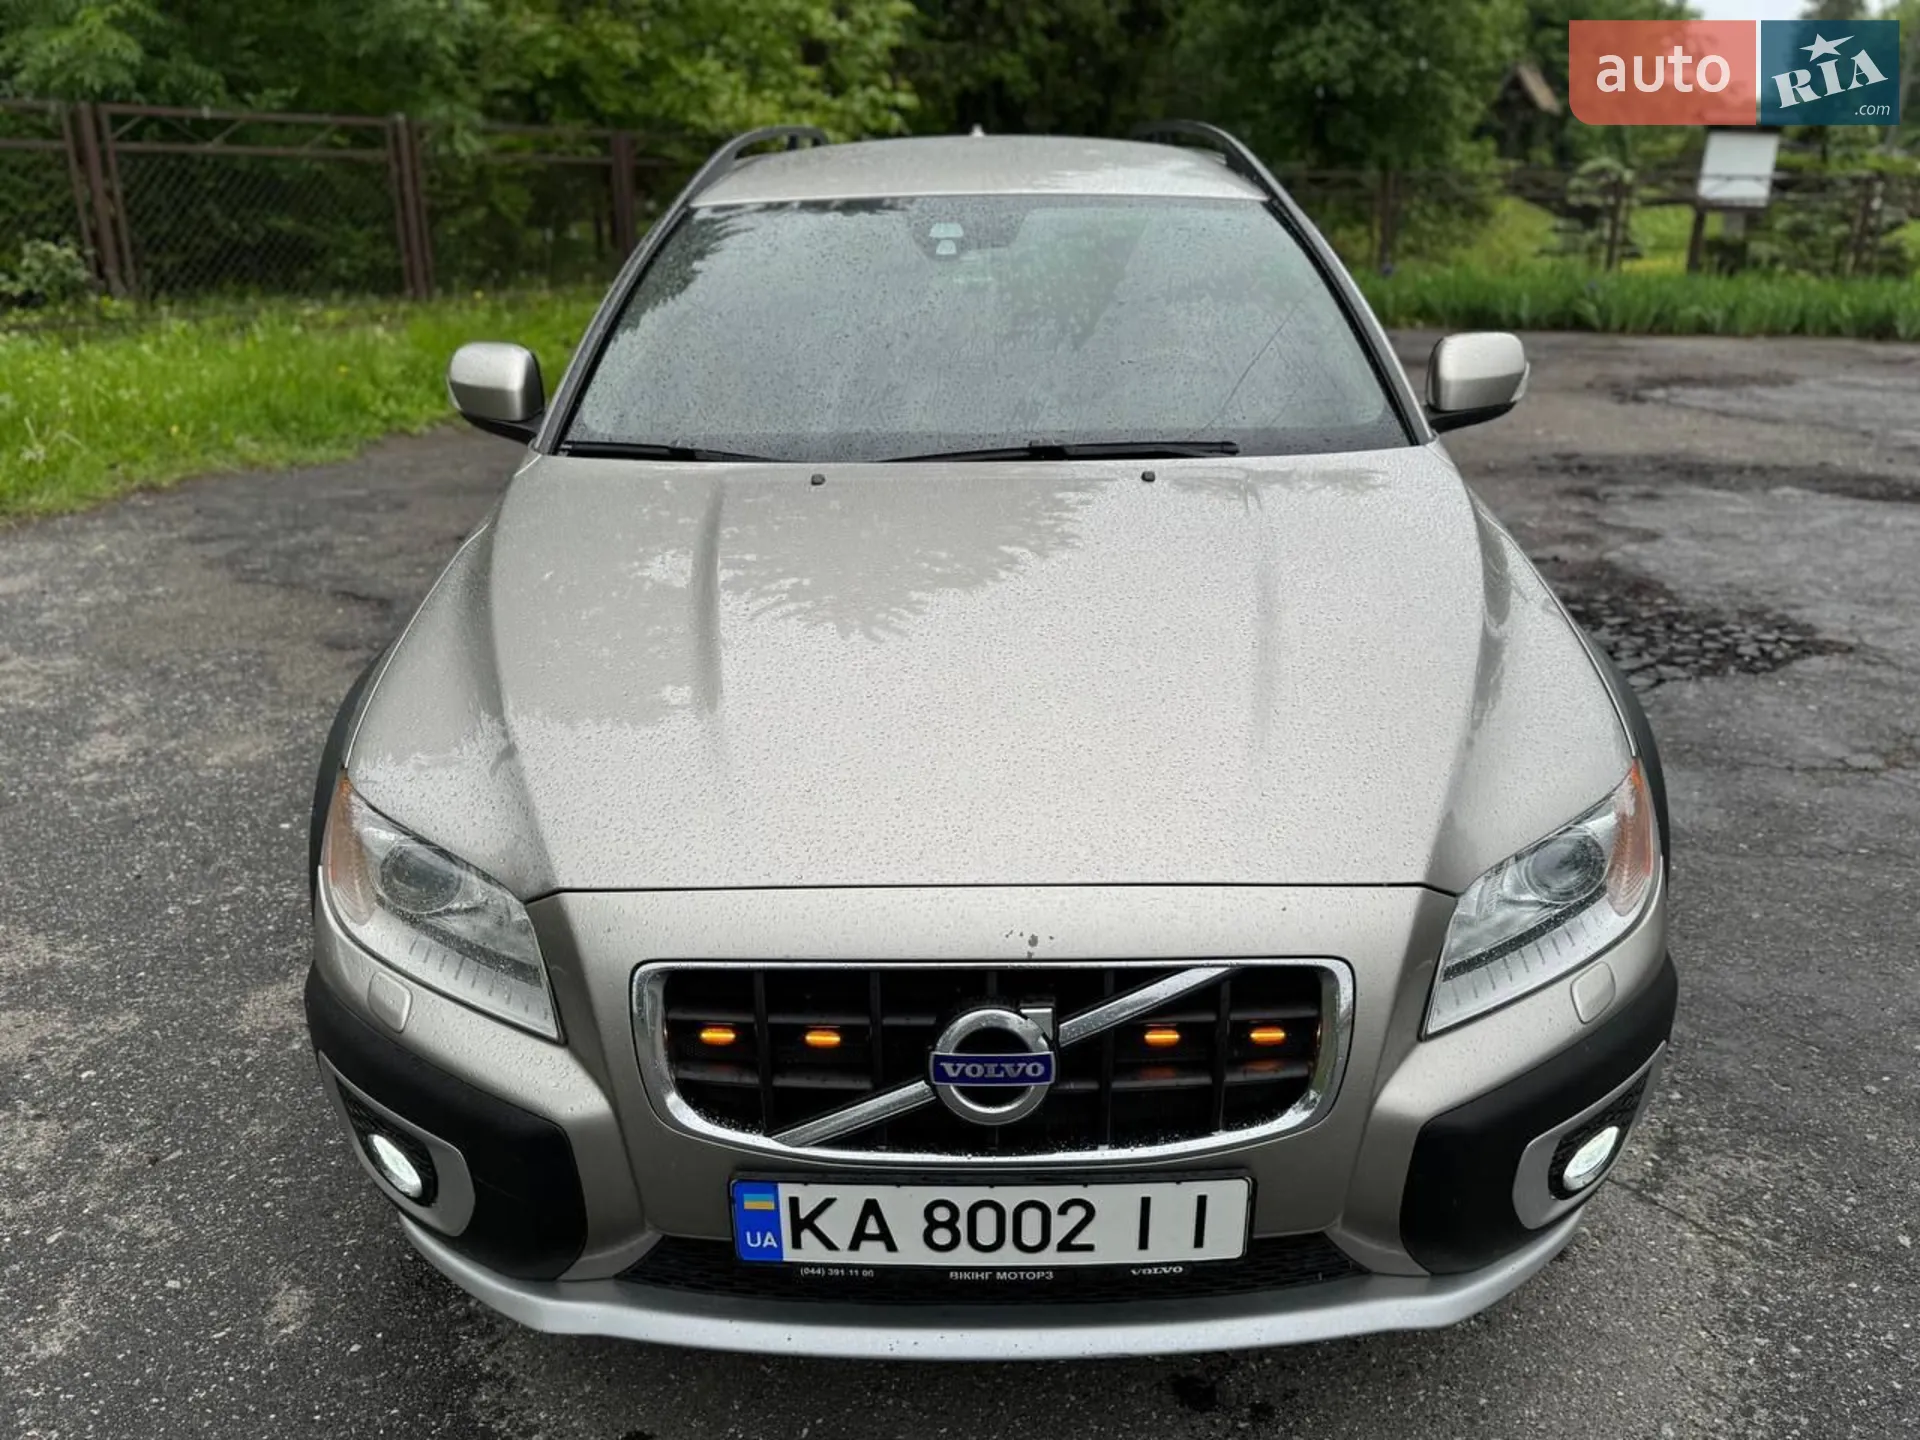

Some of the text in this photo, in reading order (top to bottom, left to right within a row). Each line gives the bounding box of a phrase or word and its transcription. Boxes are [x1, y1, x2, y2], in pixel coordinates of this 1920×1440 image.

[939, 1061, 1045, 1078] VOLVO
[788, 1196, 899, 1253] KA
[922, 1198, 1096, 1252] 8002
[746, 1231, 778, 1248] UA
[1131, 1266, 1183, 1275] VOLVO
